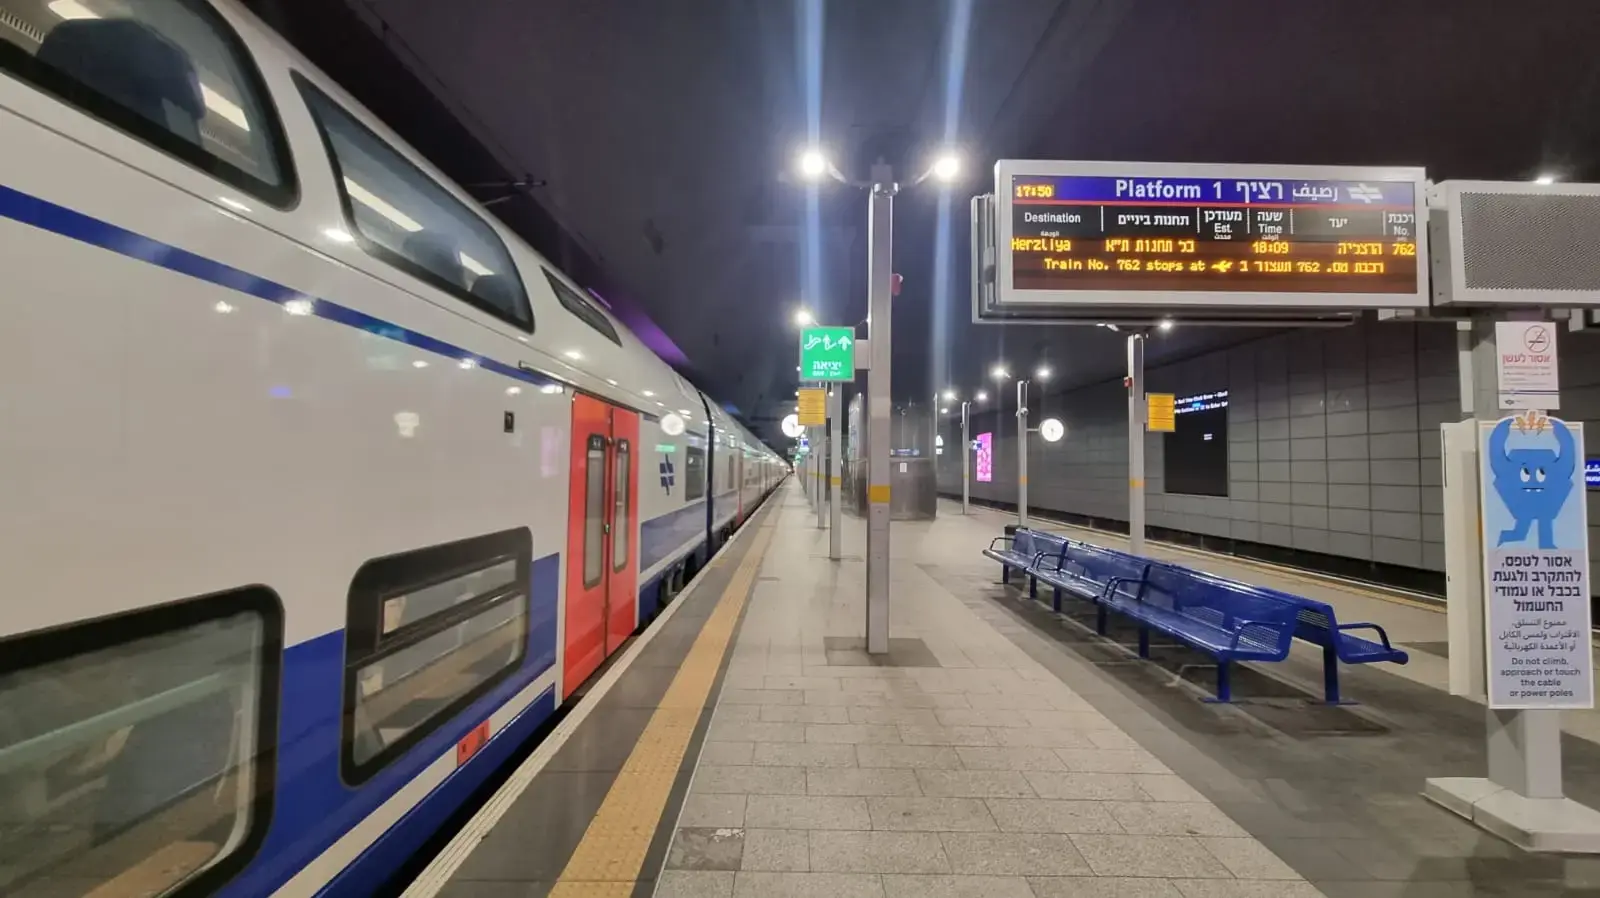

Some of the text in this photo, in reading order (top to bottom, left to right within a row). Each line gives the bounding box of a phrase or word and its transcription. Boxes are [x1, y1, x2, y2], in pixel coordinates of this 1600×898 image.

[1016, 185, 1053, 198] 17:50
[1116, 179, 1222, 199] Platform 1
[1236, 181, 1283, 203] רציף
[1292, 183, 1338, 201] رصيف
[1024, 212, 1081, 224] Destination
[1118, 213, 1190, 226] תחנות ביניים
[1204, 210, 1243, 223] מעודכן
[1257, 211, 1283, 222] שעה
[1328, 217, 1348, 228] יעד
[1388, 213, 1415, 224] רכבת
[1214, 223, 1233, 233] Est.
[1258, 223, 1283, 234] Time
[1393, 225, 1410, 236] No.
[1011, 238, 1072, 252] Herzliya
[1135, 239, 1173, 253] תחנות
[1178, 239, 1195, 252] כל
[1252, 241, 1289, 254] 18:09
[1337, 242, 1383, 255] הרצליה
[1391, 243, 1416, 255] 762
[1044, 258, 1206, 272] Train No. 762 stops at
[1254, 261, 1292, 273] תעצור
[1296, 261, 1321, 273] 762
[1354, 261, 1385, 273] רכבת
[812, 360, 842, 370] יציאה
[1503, 353, 1551, 365] אסור לעשן
[1501, 554, 1572, 568] אסור לטפס,
[1493, 569, 1582, 584] להתקרב ולגעת
[1495, 585, 1581, 597] בכבל או עמודי
[1513, 599, 1564, 612] החשמול
[1511, 657, 1524, 665] Do
[1526, 657, 1540, 665] not
[1500, 668, 1542, 677] approach
[1555, 668, 1581, 676] touch
[1537, 679, 1561, 687] cable
[1521, 690, 1547, 699] power
[1549, 689, 1574, 698] poles
